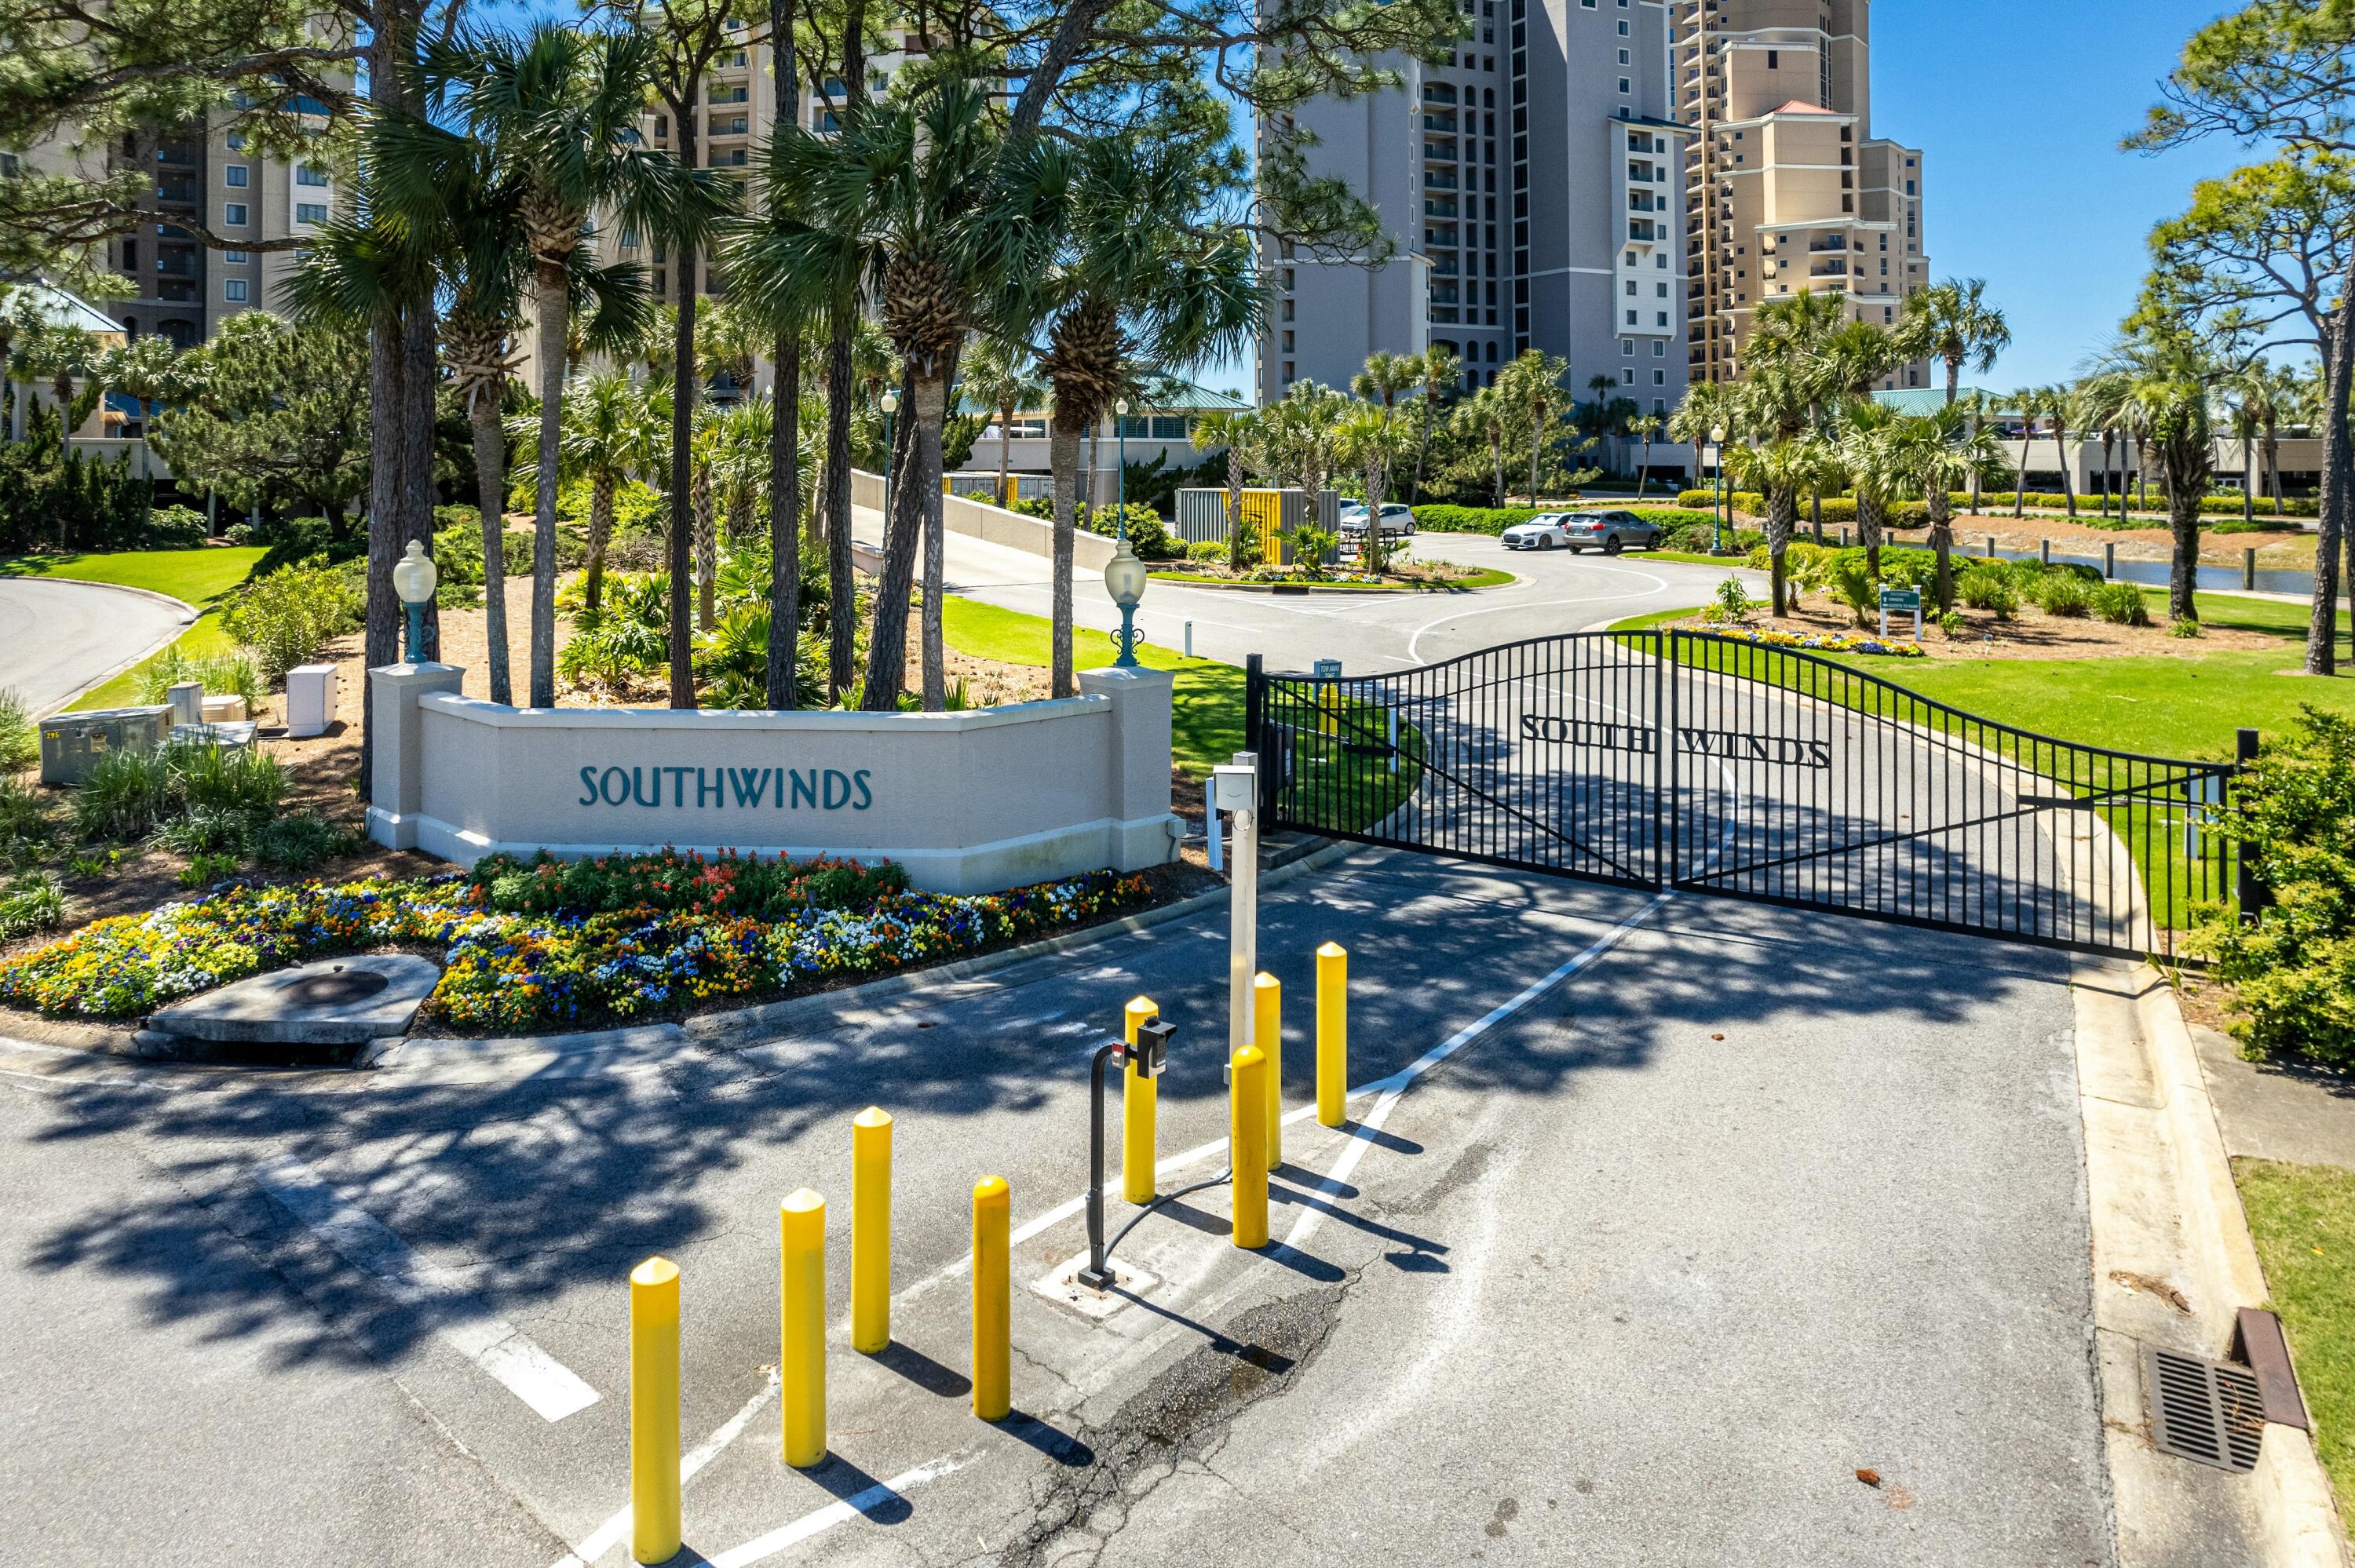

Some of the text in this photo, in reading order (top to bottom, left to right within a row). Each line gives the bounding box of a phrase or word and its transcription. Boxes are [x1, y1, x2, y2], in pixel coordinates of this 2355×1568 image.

[1521, 713, 1831, 769] SOUTH WINDS
[579, 765, 873, 810] SOUTHWINDS
